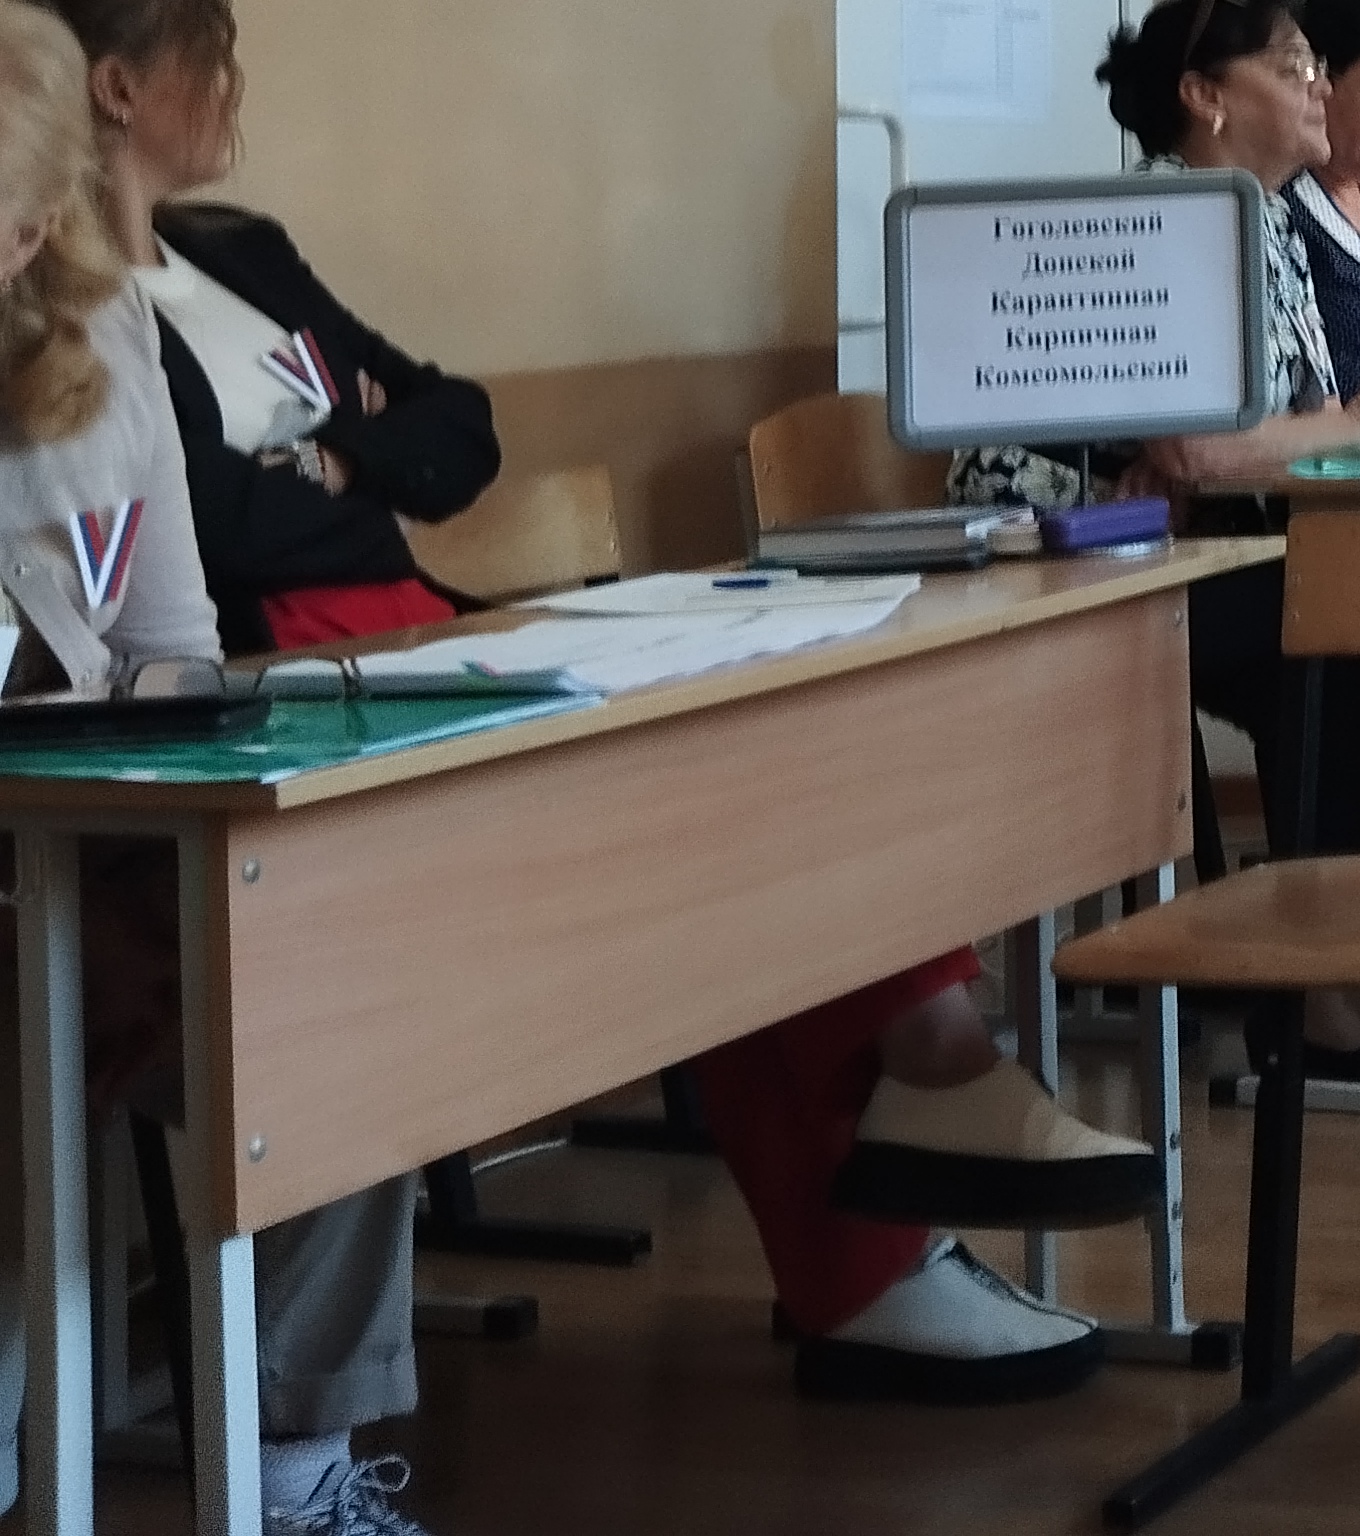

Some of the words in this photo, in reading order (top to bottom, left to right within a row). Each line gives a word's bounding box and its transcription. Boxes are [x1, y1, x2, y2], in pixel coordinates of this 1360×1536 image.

[993, 210, 1163, 242] Гоголевский
[1022, 248, 1136, 279] Донской
[991, 287, 1170, 318] Карантинная
[1005, 324, 1158, 354] Кирпичная
[974, 355, 1189, 392] Комсомольский
